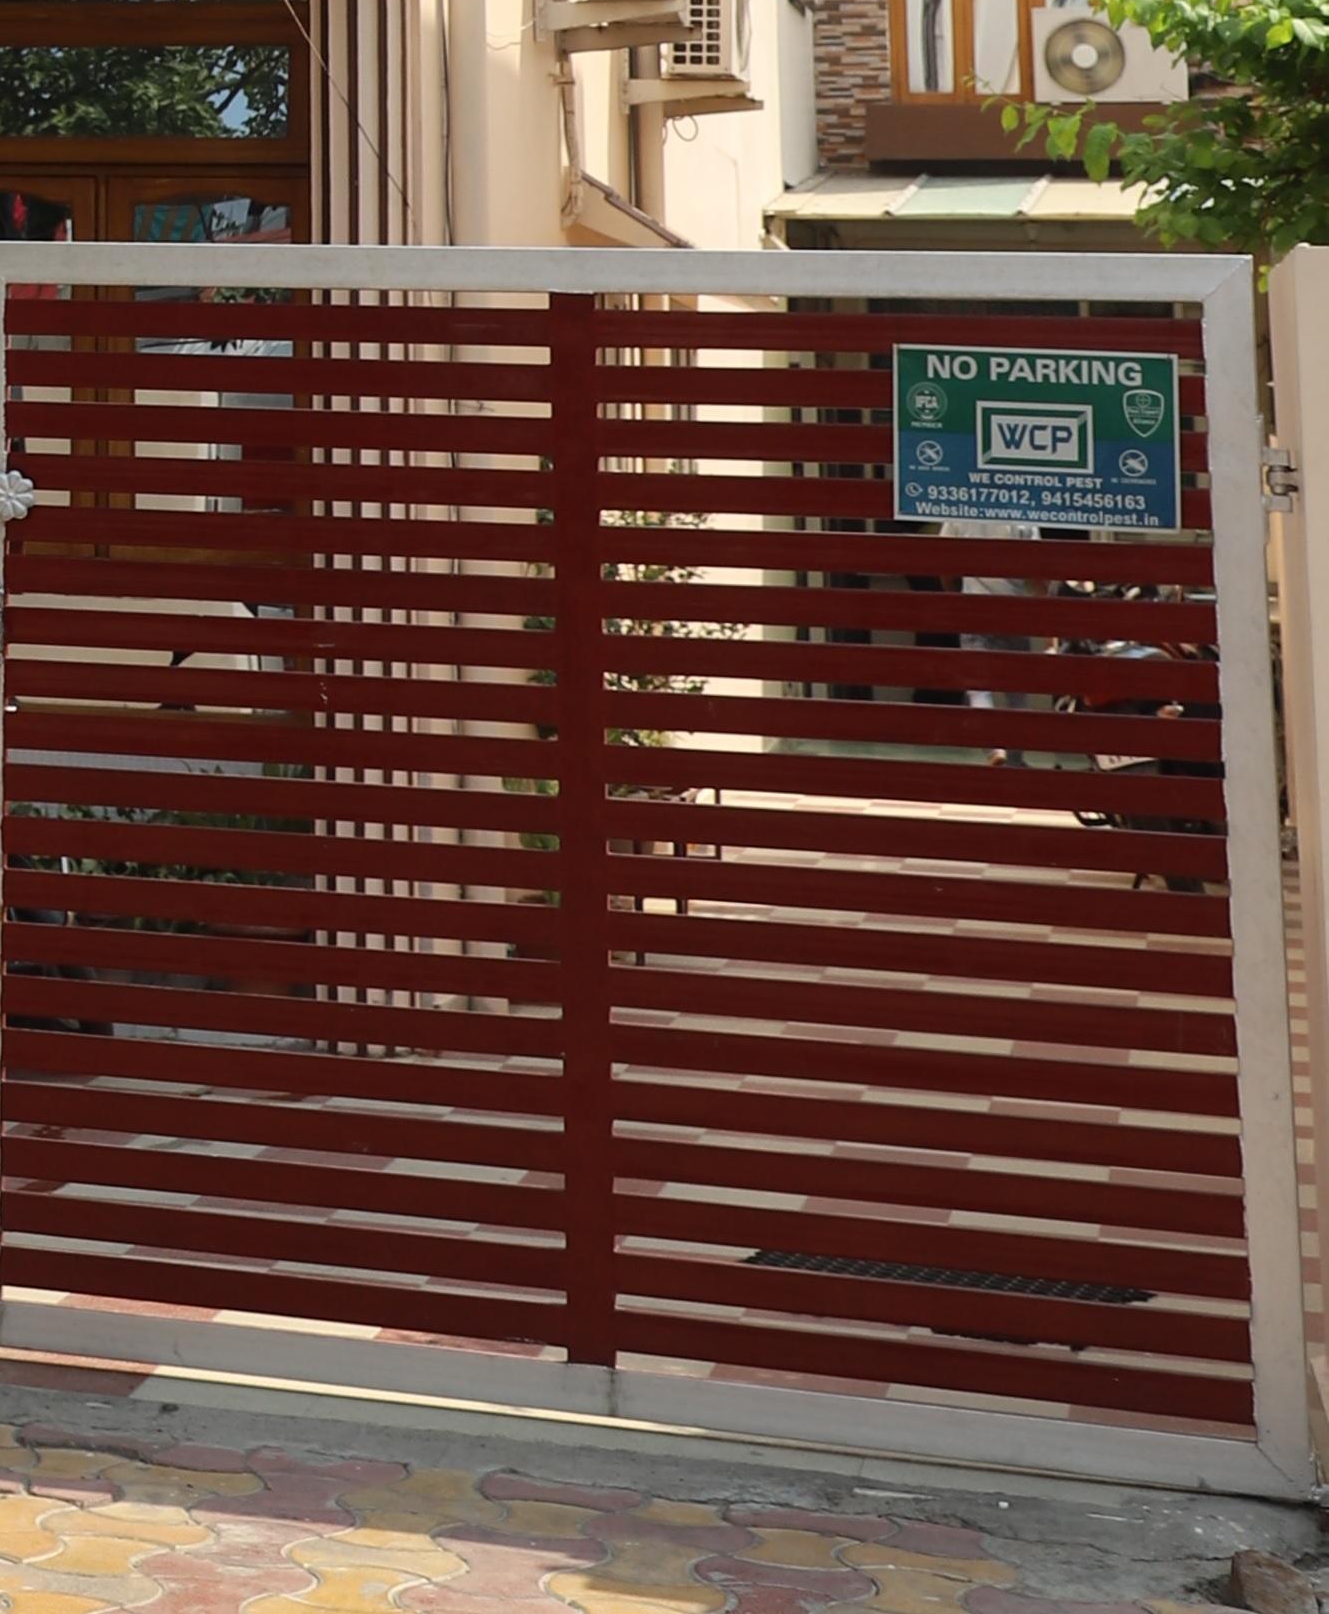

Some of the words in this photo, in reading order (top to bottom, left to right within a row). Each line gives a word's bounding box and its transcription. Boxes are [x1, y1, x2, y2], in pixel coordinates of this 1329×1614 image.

[927, 354, 977, 380] NO
[990, 356, 1142, 386] PARKING
[996, 423, 1072, 455] WCP
[969, 473, 990, 484] WE
[994, 474, 1062, 486] CONTROL
[1066, 476, 1103, 489] PEST
[1042, 491, 1145, 510] 9415456163
